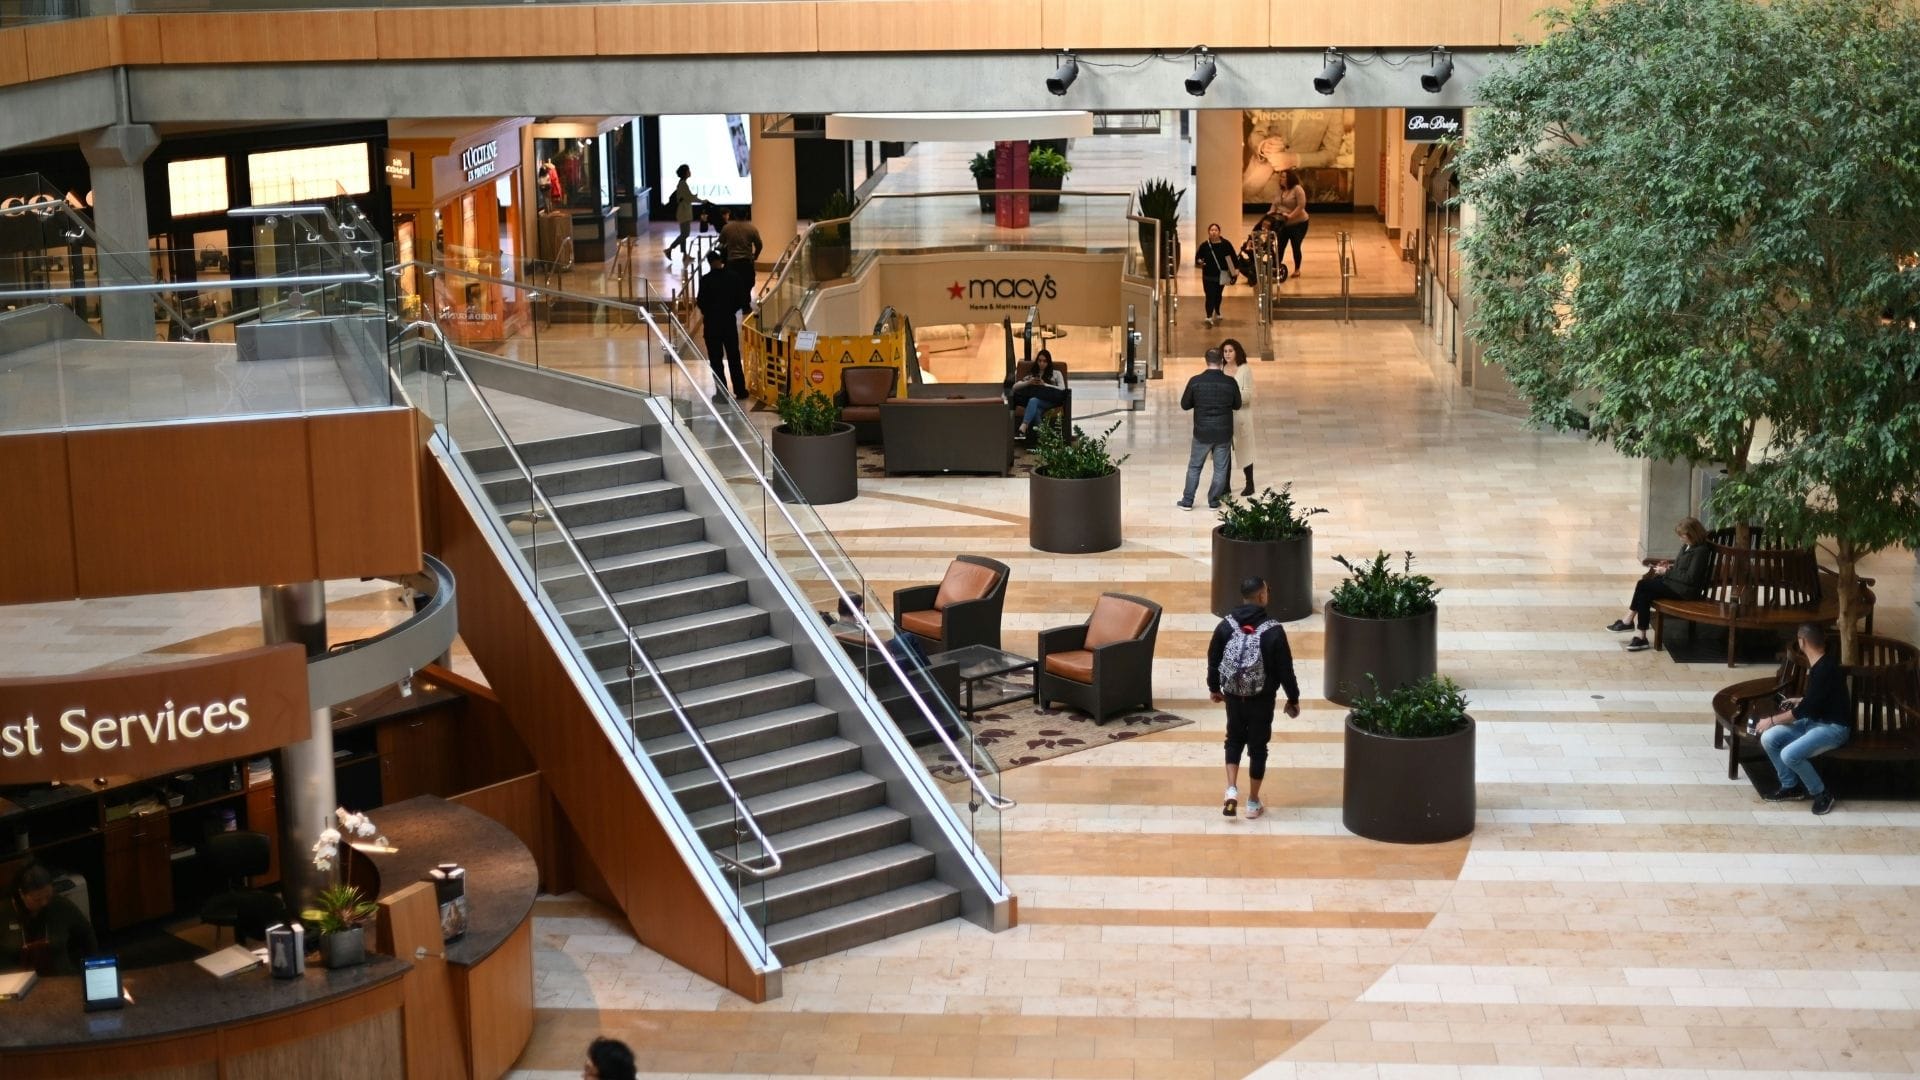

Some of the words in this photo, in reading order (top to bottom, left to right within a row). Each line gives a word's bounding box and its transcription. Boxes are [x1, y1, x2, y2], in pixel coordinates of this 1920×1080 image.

[1259, 111, 1324, 120] INDOCINO
[1408, 115, 1429, 130] Ben
[1430, 115, 1459, 133] Bridge
[969, 273, 1057, 305] macy's
[60, 698, 250, 753] Services
